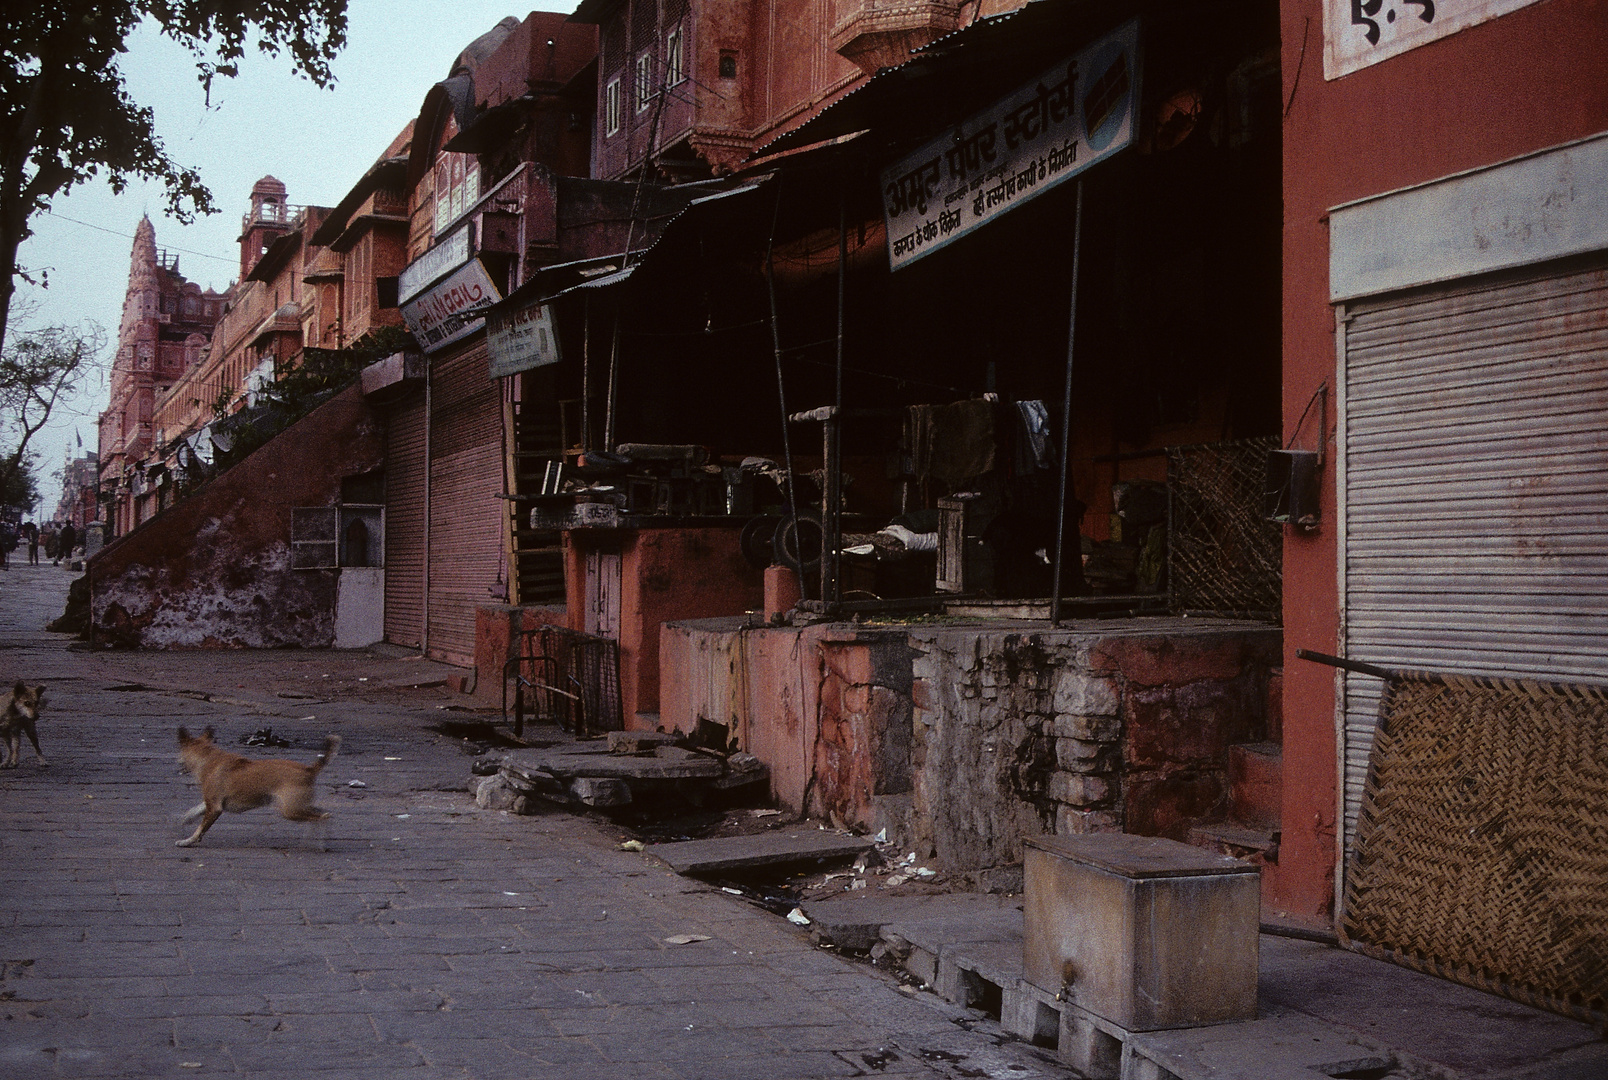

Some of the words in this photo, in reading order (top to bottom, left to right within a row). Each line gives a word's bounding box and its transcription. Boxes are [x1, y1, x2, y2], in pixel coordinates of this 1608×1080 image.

[886, 155, 941, 217] अमृत
[945, 125, 998, 182] पेपर
[1004, 61, 1079, 150] स्टोर्स
[1017, 161, 1037, 191] कापी
[1038, 157, 1047, 180] के
[1048, 139, 1079, 175] निर्माता
